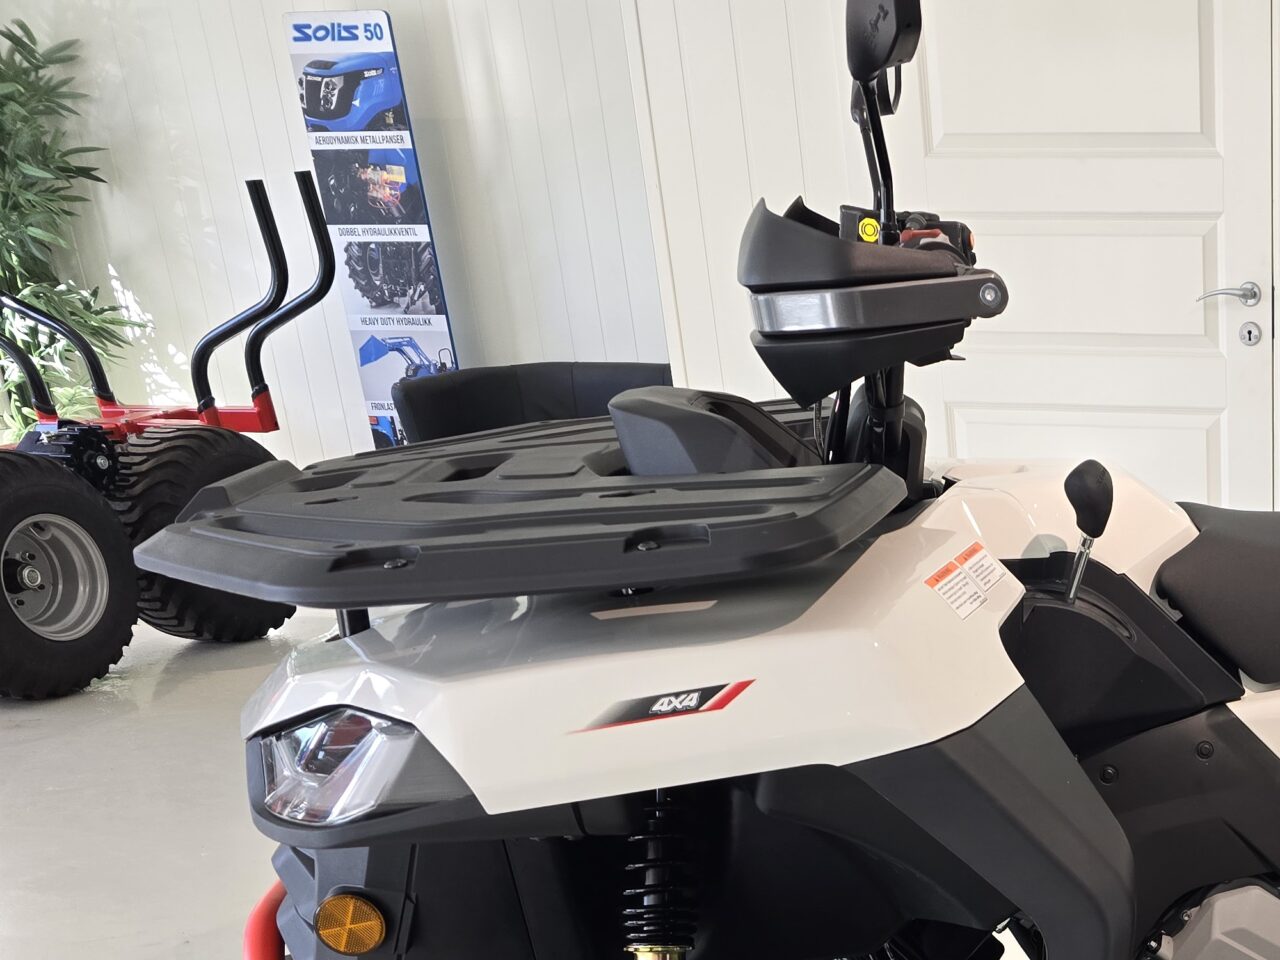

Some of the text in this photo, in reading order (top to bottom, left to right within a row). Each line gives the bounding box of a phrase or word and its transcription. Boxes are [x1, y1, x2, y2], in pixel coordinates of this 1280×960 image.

[363, 22, 384, 41] 50
[314, 135, 405, 145] AERODYNAMISK METALLPANSER
[338, 227, 418, 237] DOBBEL HYDRAULIKKVENTIL
[360, 317, 432, 326] HEAVY DUTY HYDRAULIKK
